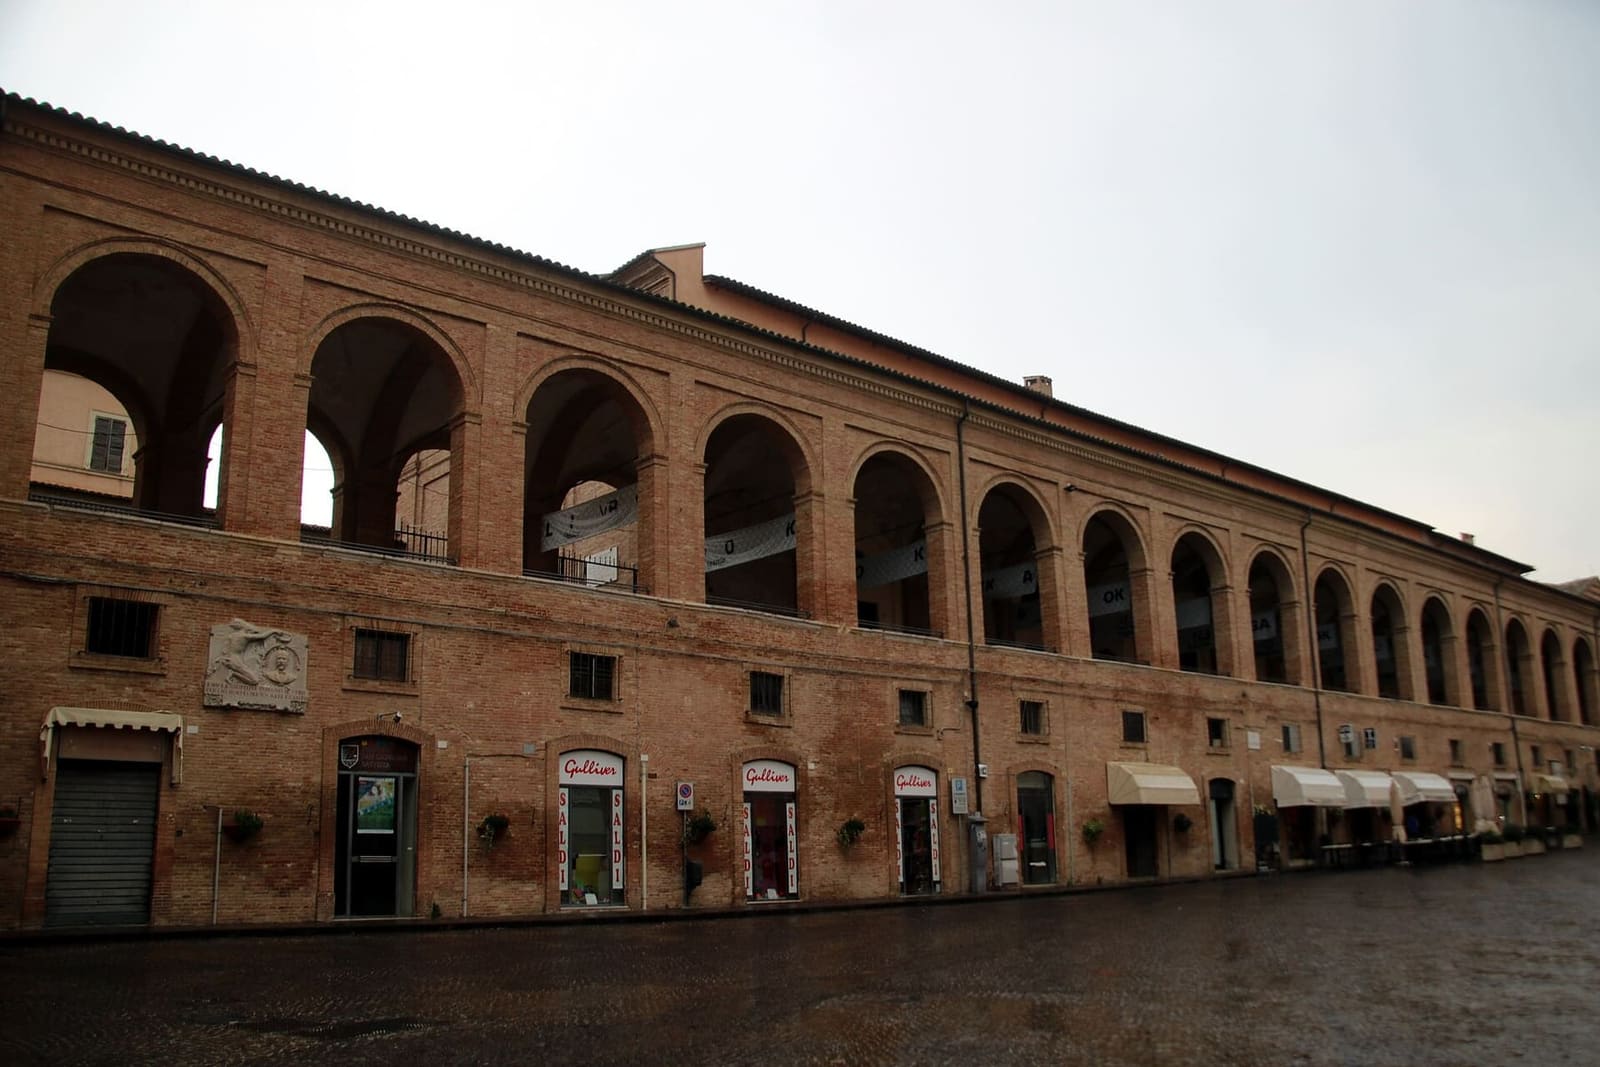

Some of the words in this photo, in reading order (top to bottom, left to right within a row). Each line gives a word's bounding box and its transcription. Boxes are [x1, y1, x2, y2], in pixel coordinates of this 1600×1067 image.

[564, 759, 617, 778] Gulliver
[746, 768, 789, 785] Gulliver
[897, 775, 931, 790] Gulliver
[559, 792, 567, 884] SALDI
[930, 802, 938, 877] SALDI
